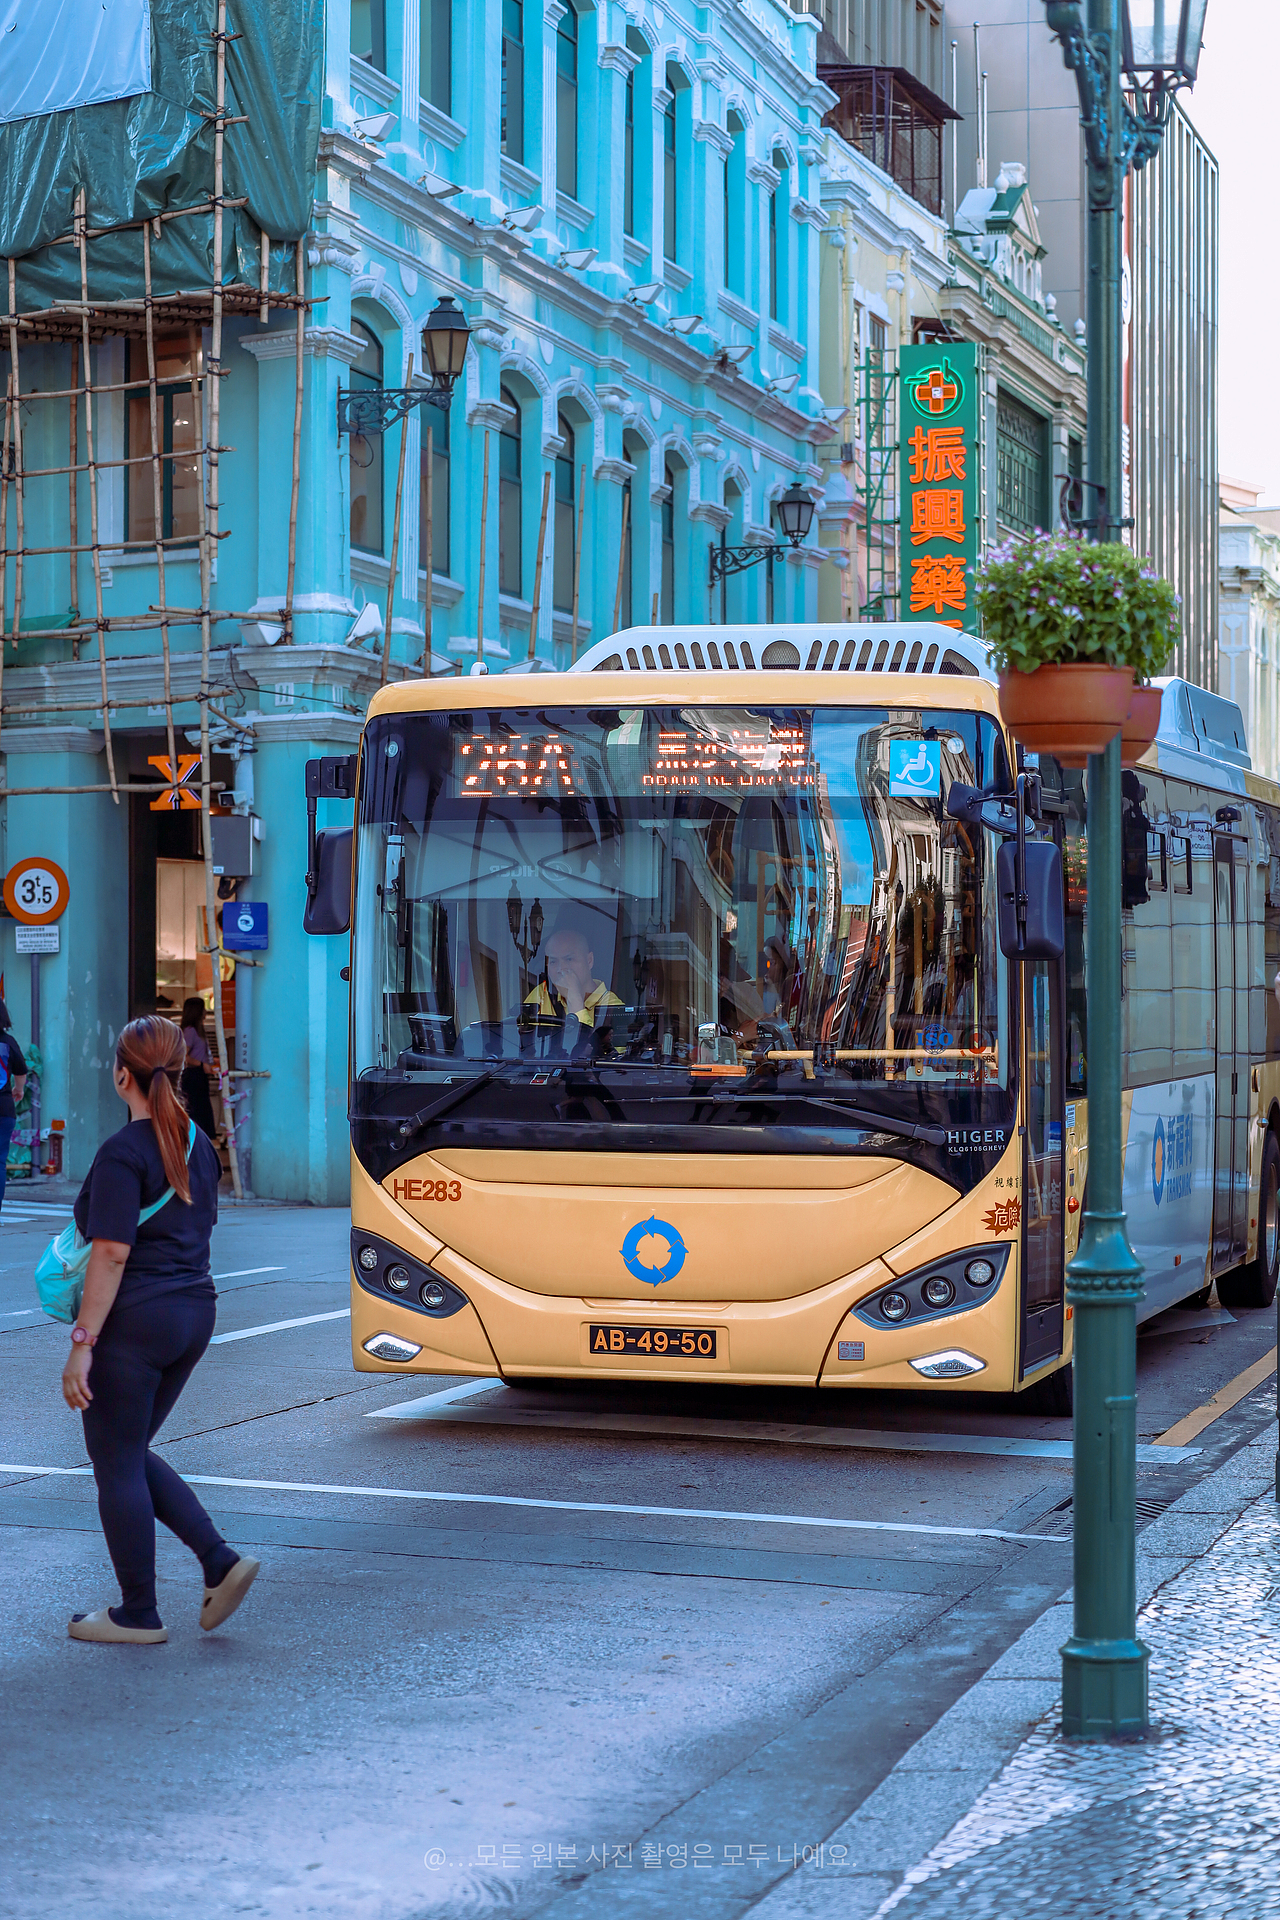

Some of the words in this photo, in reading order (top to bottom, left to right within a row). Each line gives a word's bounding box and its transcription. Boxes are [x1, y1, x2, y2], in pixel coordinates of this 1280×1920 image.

[908, 425, 967, 632] 振興藥
[916, 1032, 954, 1046] ISO
[923, 1057, 947, 1065] 27001
[947, 1129, 1005, 1144] HIGER
[1166, 1112, 1194, 1172] 新福利
[393, 1178, 462, 1202] HE283
[994, 1206, 1020, 1227] 危險
[593, 1328, 713, 1355] AB-49-50
